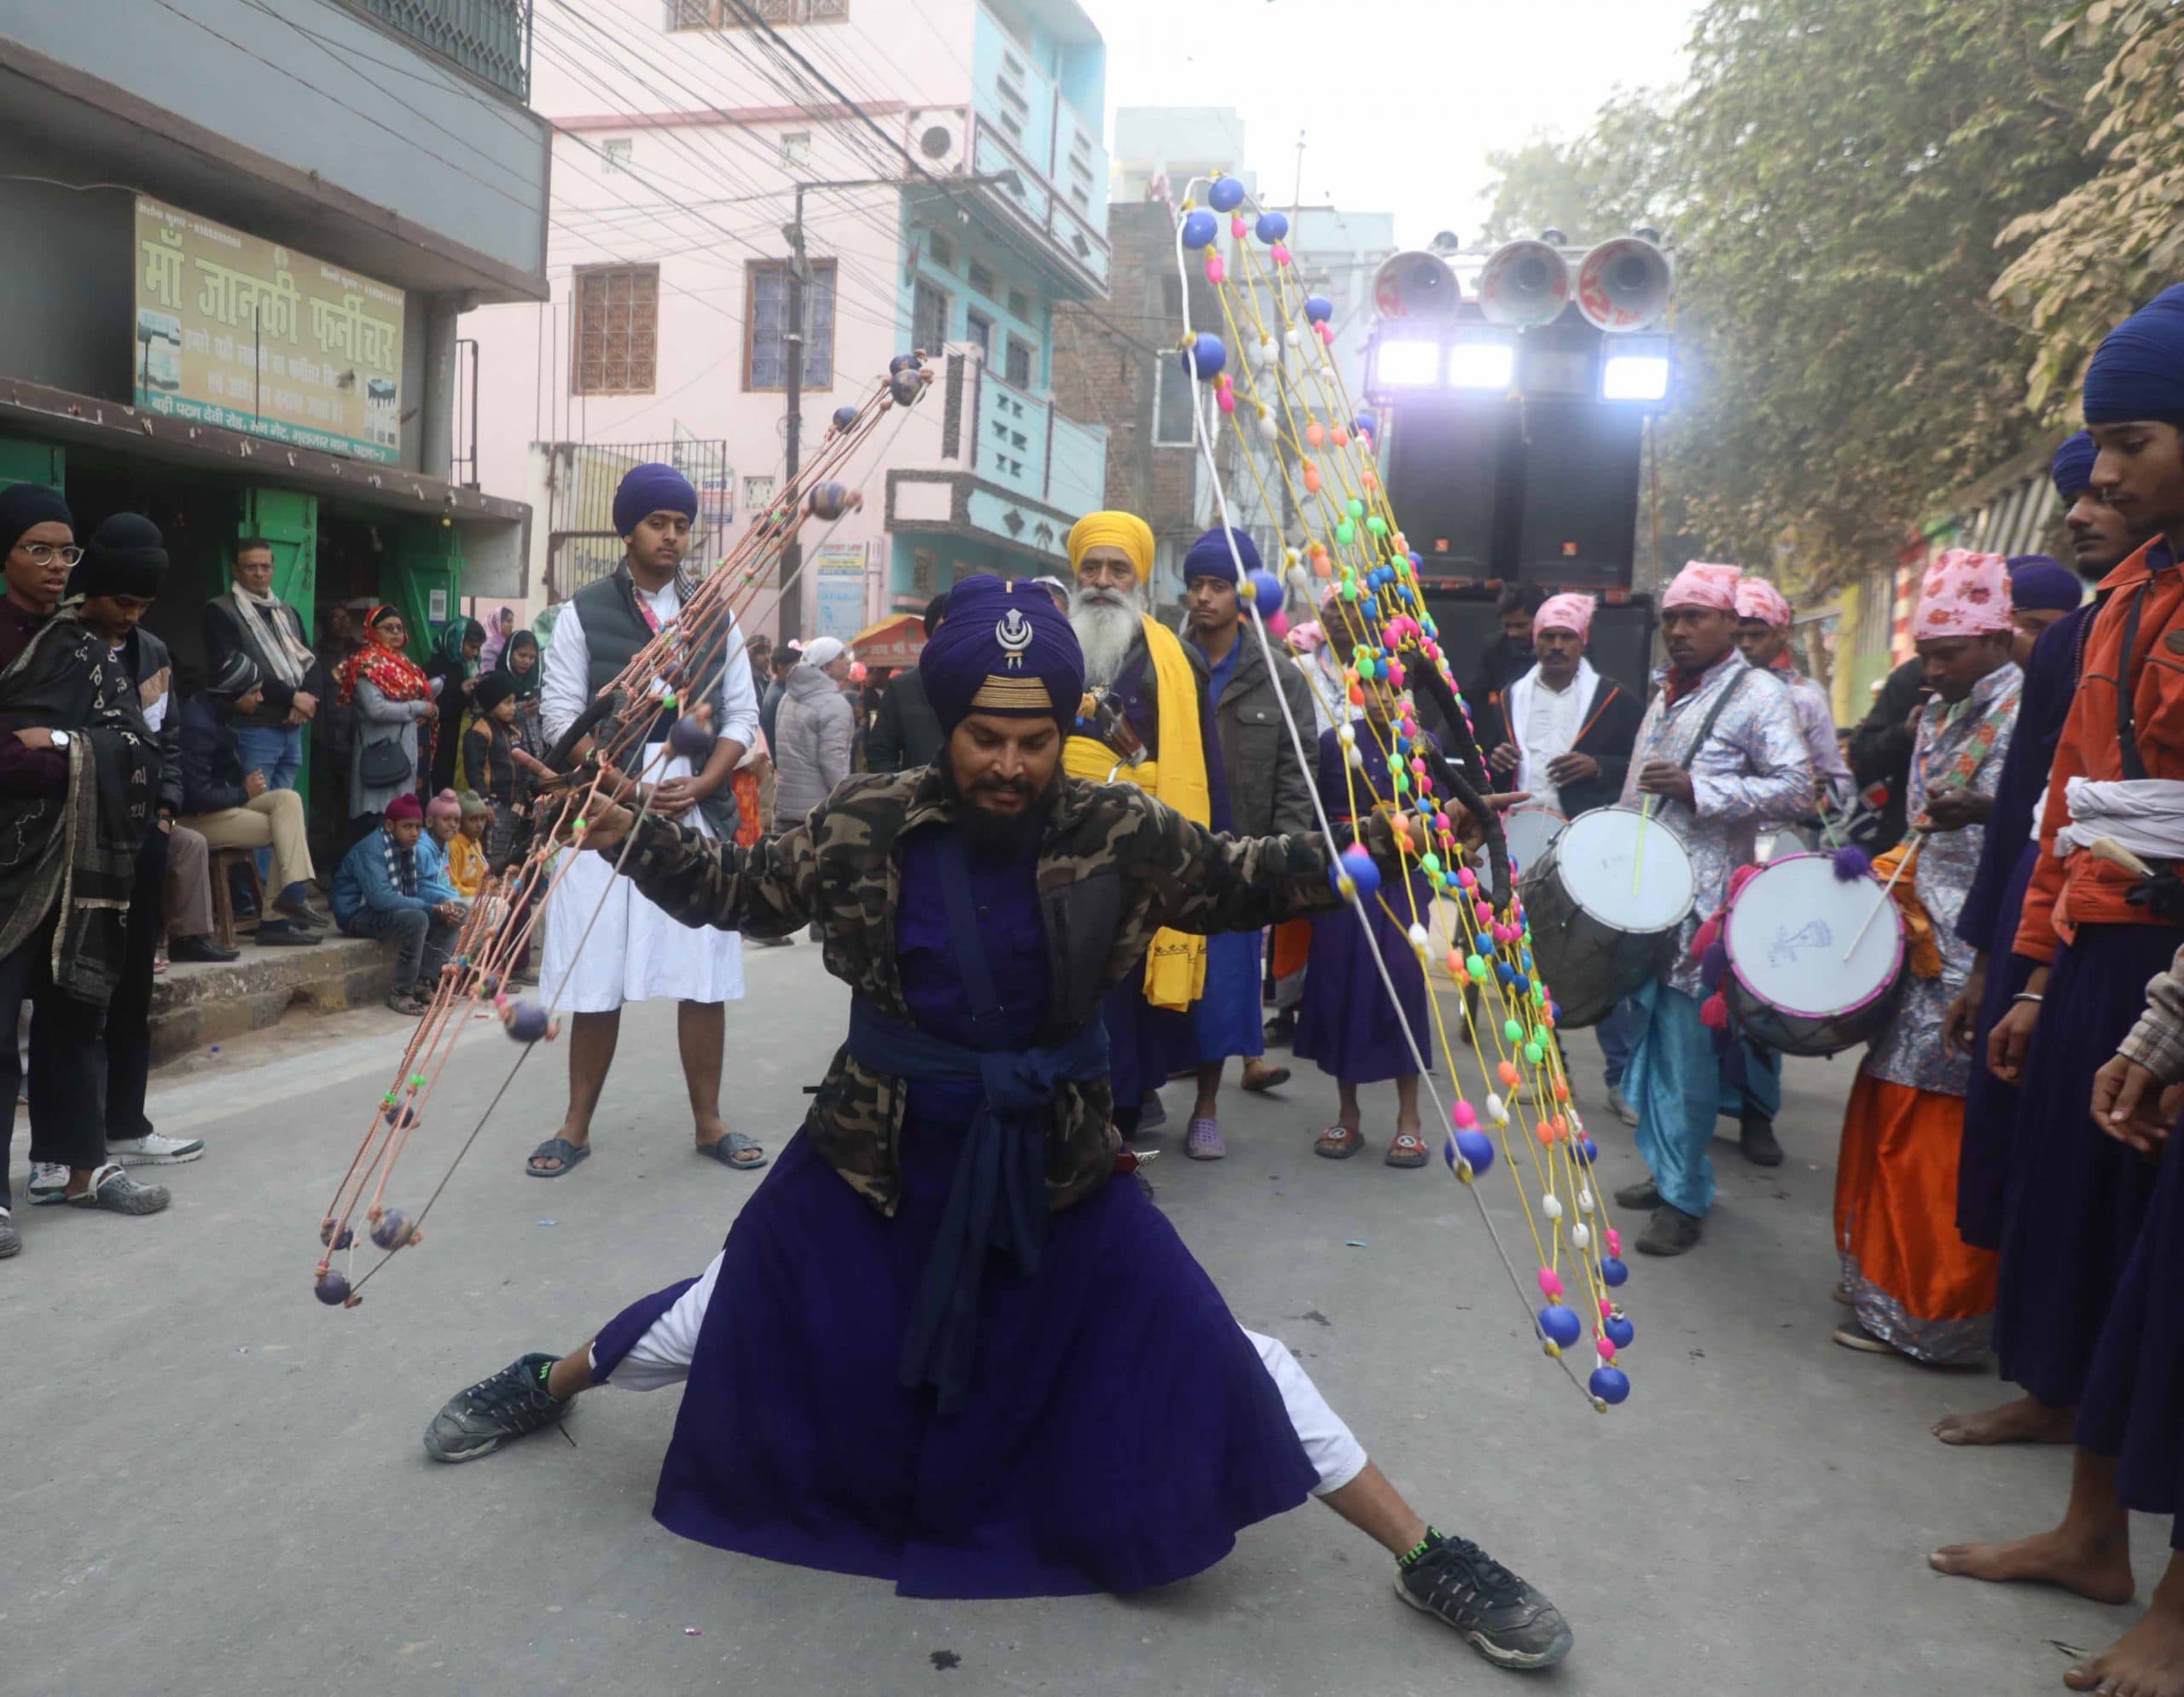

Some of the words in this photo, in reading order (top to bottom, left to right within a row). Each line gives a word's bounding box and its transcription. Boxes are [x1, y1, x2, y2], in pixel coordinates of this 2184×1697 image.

[194, 256, 300, 345] जानकी
[309, 293, 397, 374] फर्नीचर
[204, 404, 223, 424] देवी
